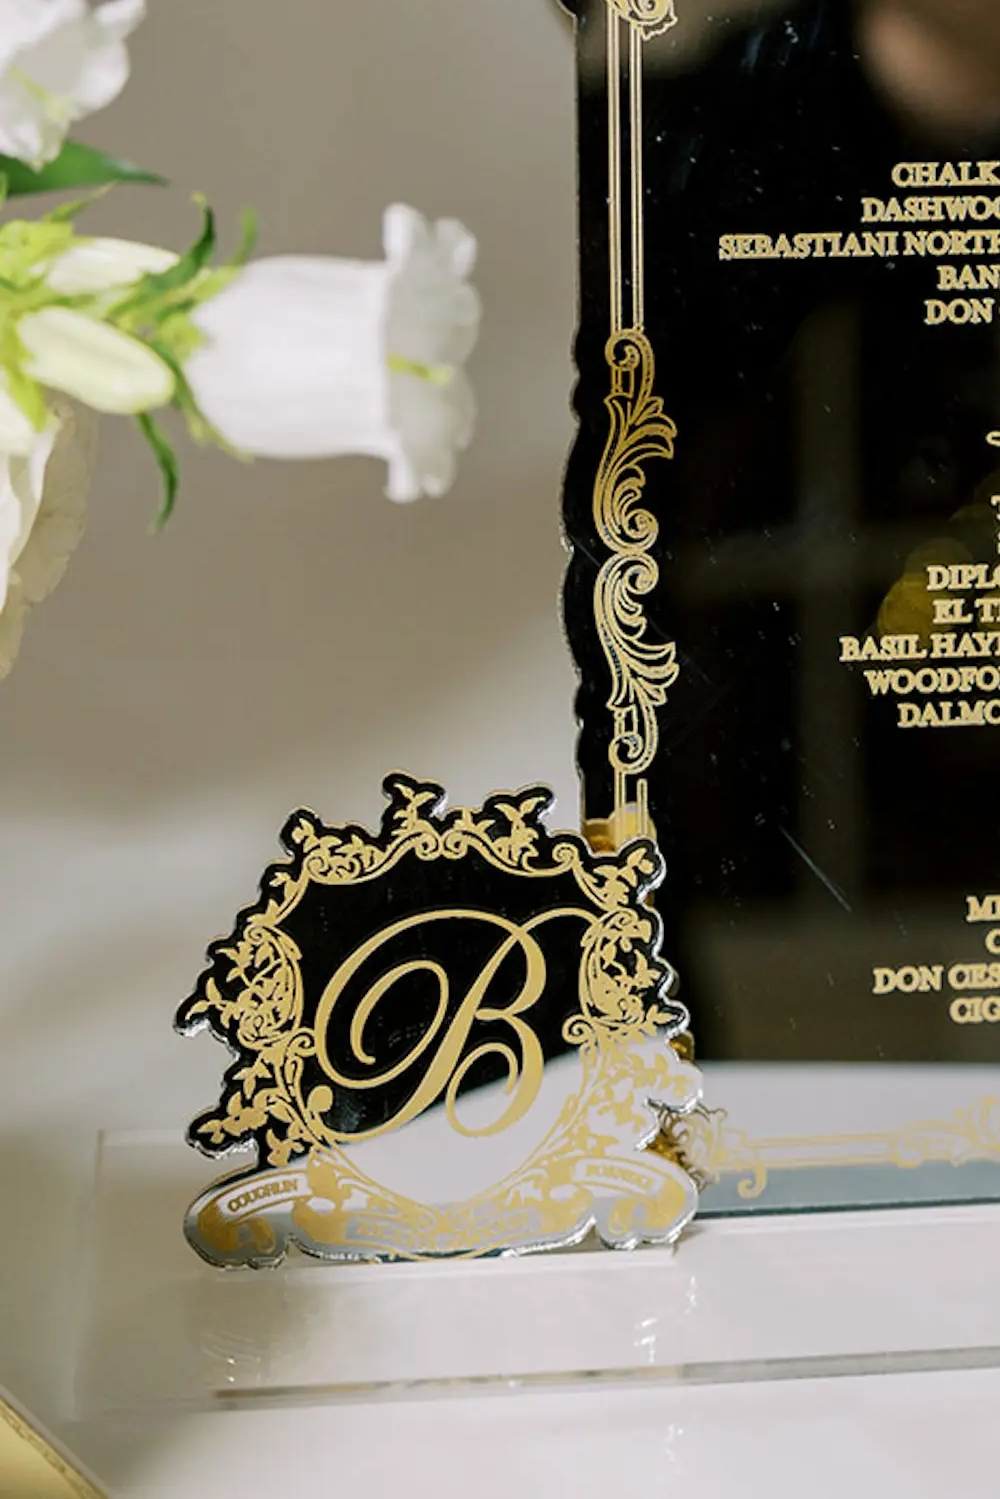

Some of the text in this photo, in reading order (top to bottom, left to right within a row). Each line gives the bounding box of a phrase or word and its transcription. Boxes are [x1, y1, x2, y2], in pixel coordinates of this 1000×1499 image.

[718, 233, 903, 259] SEBASTIANI
[926, 299, 995, 324] DON
[933, 599, 973, 624] EL
[839, 634, 927, 662] BASIL
[873, 966, 942, 994] DON
[315, 908, 600, 1140] B
